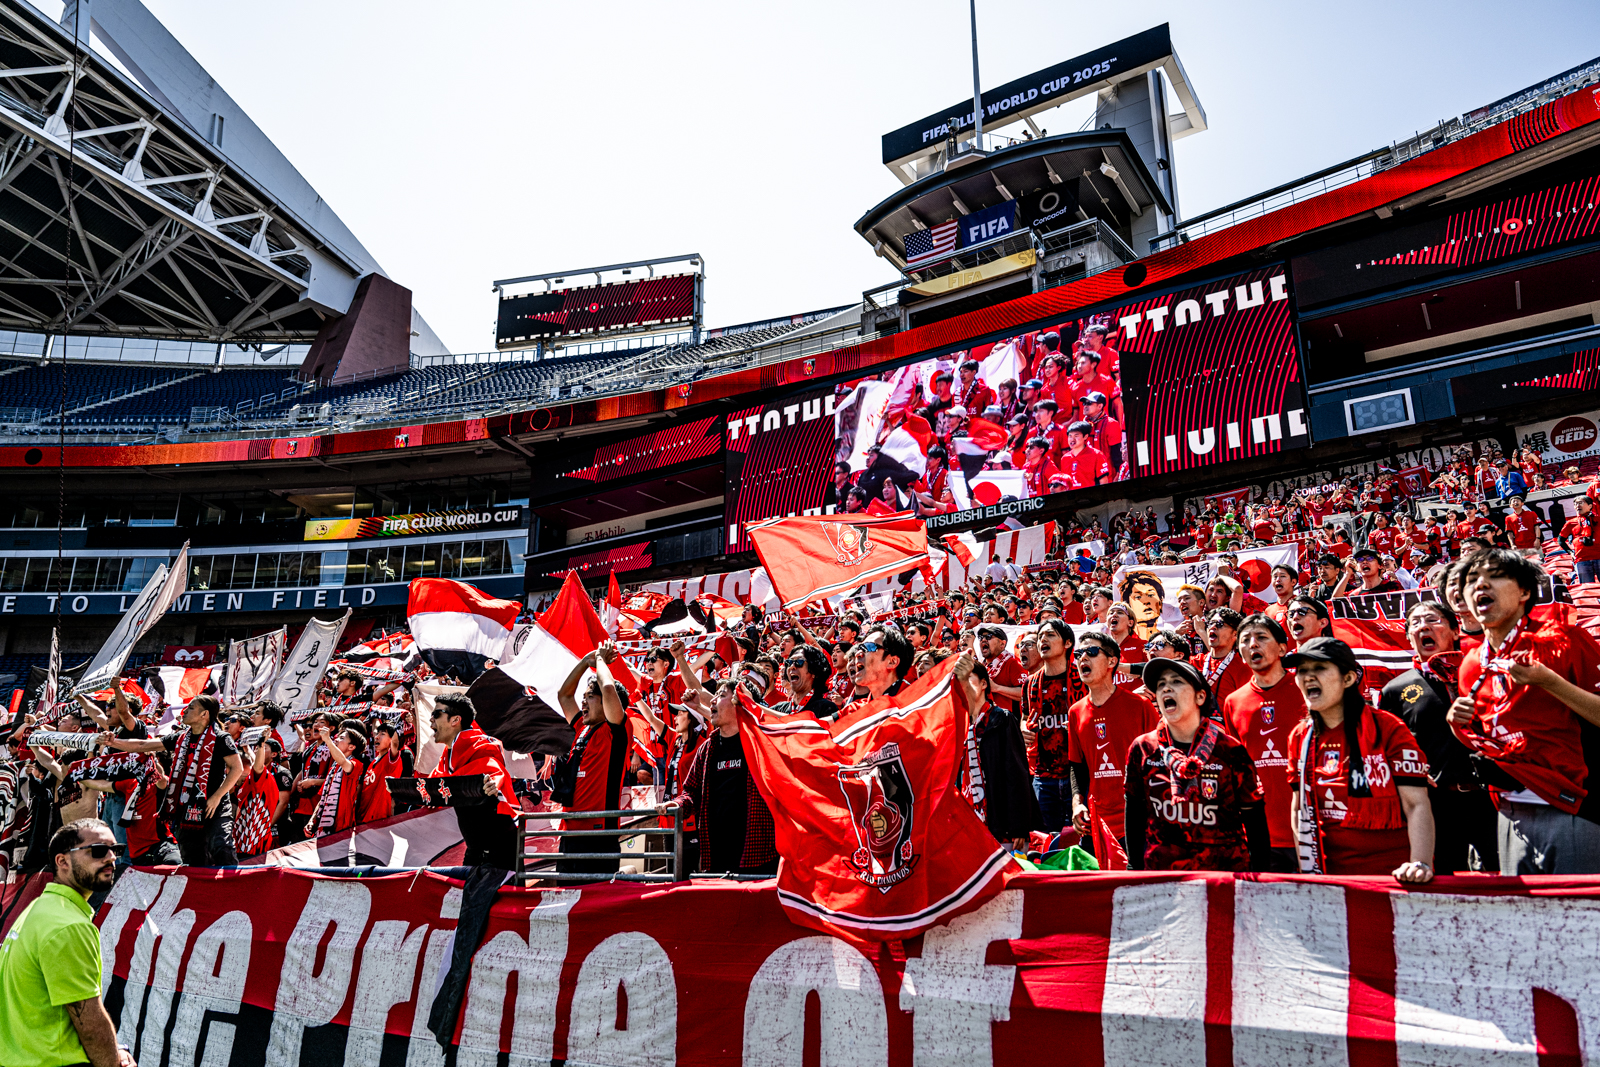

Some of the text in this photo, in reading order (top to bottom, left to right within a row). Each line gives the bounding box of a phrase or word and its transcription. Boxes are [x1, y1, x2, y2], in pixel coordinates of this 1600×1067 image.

[1493, 89, 1540, 111] TOYOTA
[1544, 78, 1566, 91] FAN
[922, 124, 949, 143] FIFA
[987, 88, 1038, 116] WORLD
[1041, 76, 1070, 95] CUP
[1033, 206, 1067, 227] Concacaf
[969, 216, 1009, 242] FIFA
[948, 270, 983, 289] FIFA
[1554, 428, 1595, 446] REDS
[1542, 451, 1582, 465] RISING
[1297, 486, 1322, 497] COME
[985, 497, 1044, 518] ELECTRIC
[382, 509, 519, 532] FIFA CLUB WORLD CUP
[47, 595, 89, 613] TO
[119, 594, 244, 613] LMEN
[272, 587, 376, 609] FIELD
[1038, 713, 1069, 730] POLU
[1149, 796, 1219, 826] POLUS
[99, 866, 253, 1067] The
[742, 888, 1024, 1067] of
